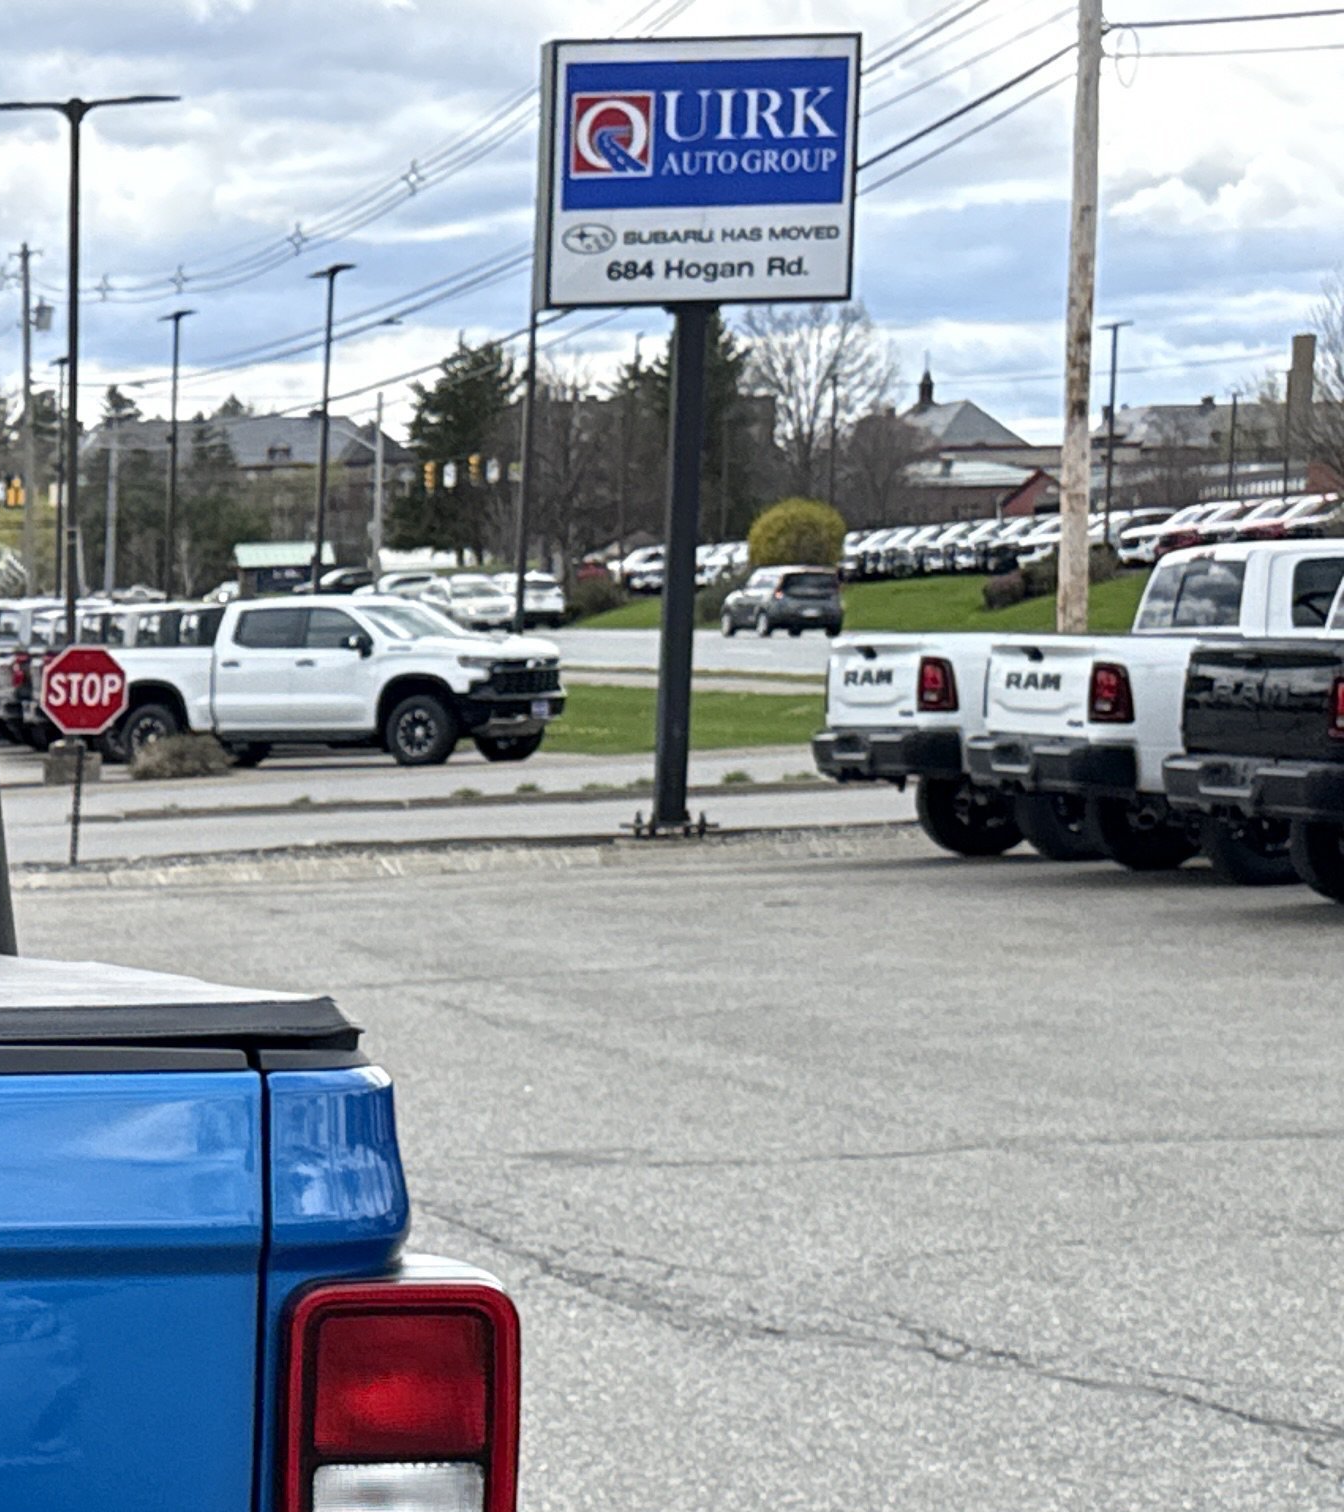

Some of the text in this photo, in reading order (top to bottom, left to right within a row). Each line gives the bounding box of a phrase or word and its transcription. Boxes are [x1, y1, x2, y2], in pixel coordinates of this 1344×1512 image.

[574, 86, 839, 175] QUIRK
[623, 226, 841, 246] SUBARU HAS MOVED
[606, 257, 809, 283] 684 Hogan Rd.
[47, 672, 122, 707] STOP
[843, 669, 894, 686] RAM
[1005, 672, 1062, 691] RAM
[1213, 676, 1289, 706] RAM
